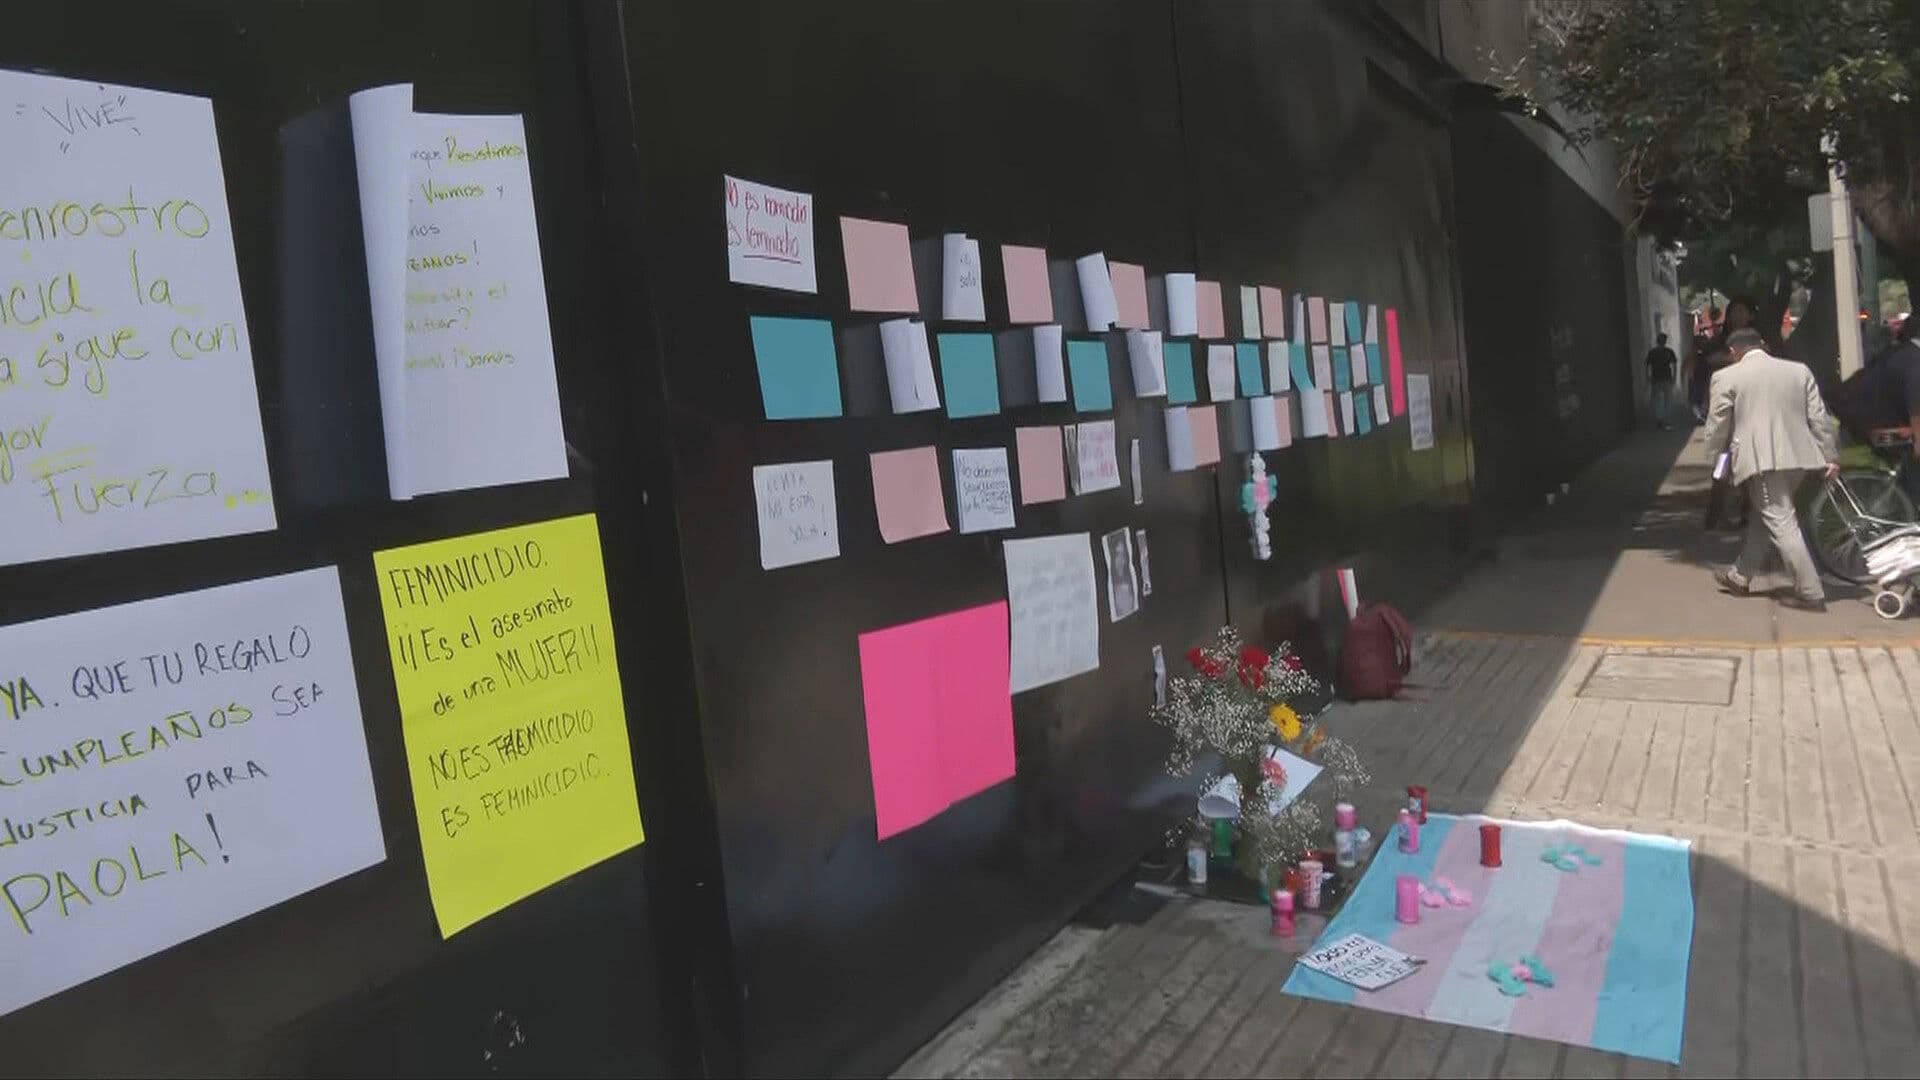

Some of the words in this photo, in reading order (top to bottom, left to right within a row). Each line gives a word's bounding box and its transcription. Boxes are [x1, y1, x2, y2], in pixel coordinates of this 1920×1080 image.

[421, 178, 485, 208] Vivimos
[132, 250, 173, 305] la
[37, 328, 148, 395] sigue
[171, 322, 238, 360] con
[461, 615, 480, 649] el
[491, 589, 573, 638] asesinato
[72, 660, 134, 700] QUE
[144, 653, 183, 687] TU
[194, 625, 311, 676] REGALO
[271, 683, 324, 717] SEA
[434, 692, 456, 716] de
[463, 677, 496, 700] una
[186, 760, 269, 800] PARA
[428, 747, 458, 790] NO
[460, 744, 491, 781] ES
[441, 804, 470, 838] ES
[2, 812, 230, 935] PAOLA!
